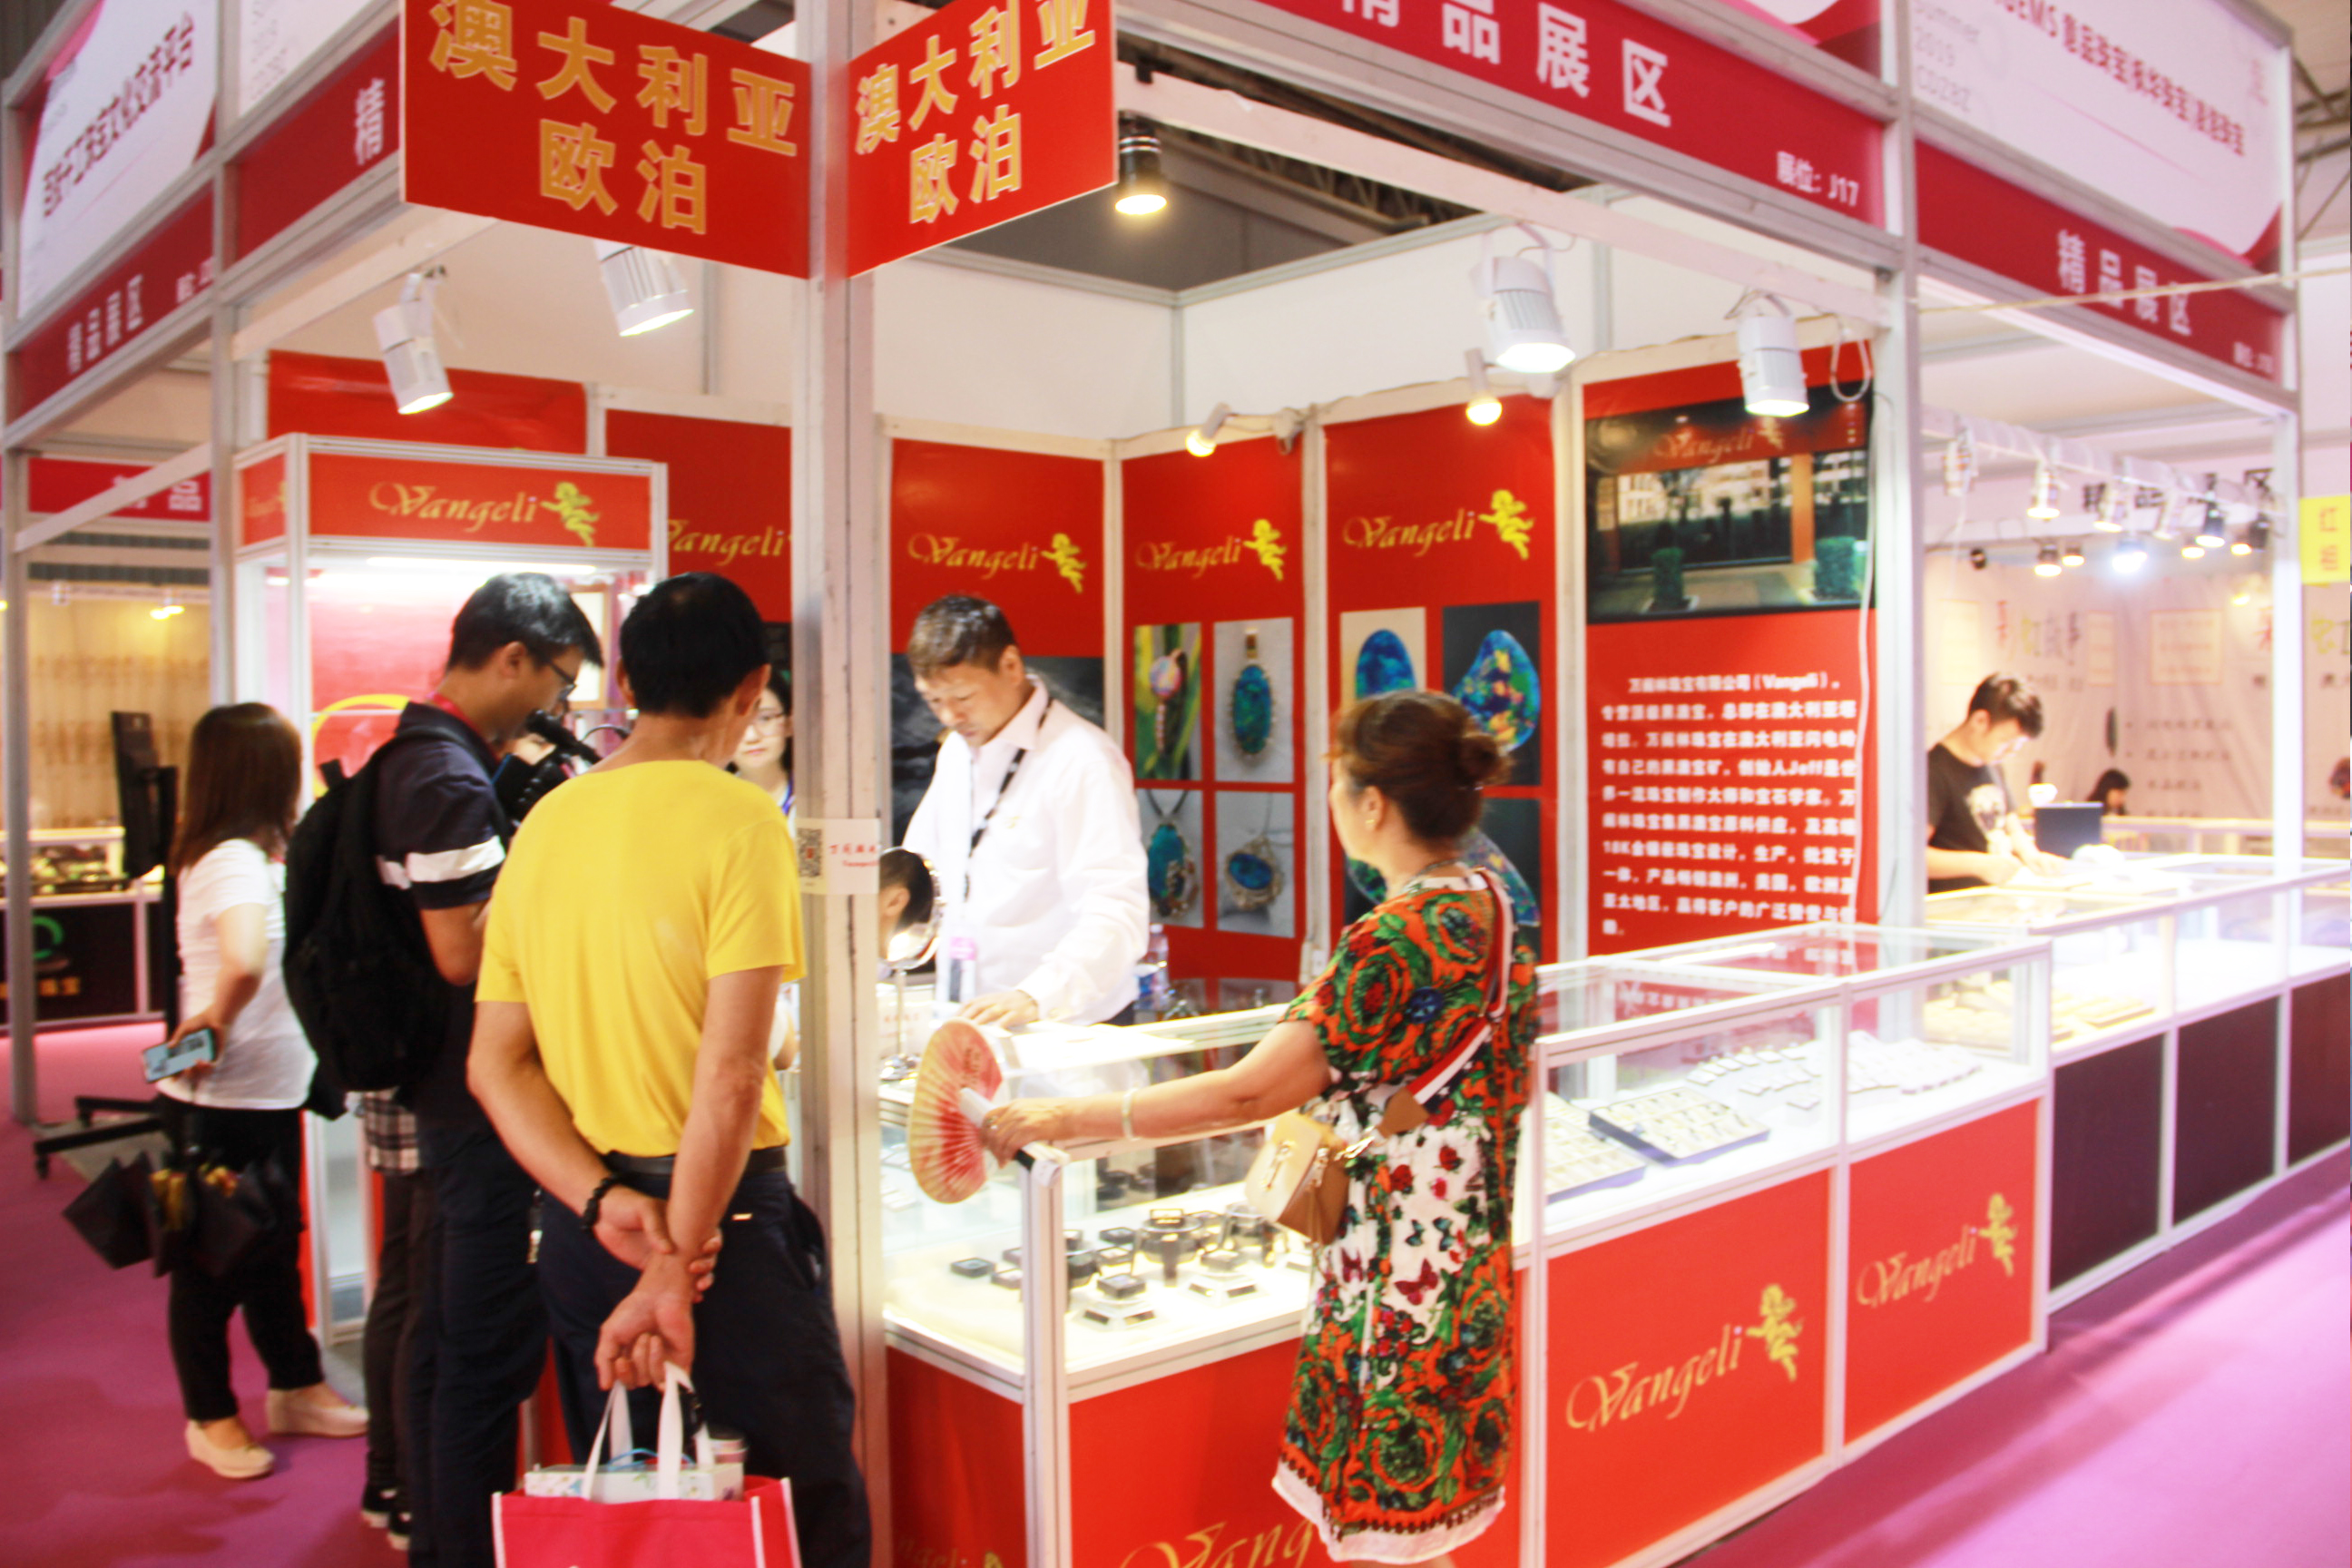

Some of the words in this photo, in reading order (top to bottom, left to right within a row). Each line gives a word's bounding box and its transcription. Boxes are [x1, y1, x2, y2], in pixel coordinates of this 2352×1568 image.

[430, 0, 798, 157] 澳大利亚
[857, 0, 1096, 154] 澳大利亚
[540, 118, 709, 235] 欧泊
[909, 104, 1023, 225] 欧泊
[1828, 173, 1859, 207] J17
[368, 481, 539, 532] Vangeli
[1341, 507, 1477, 557] Vangeli
[907, 531, 1040, 579] Vangeli
[1132, 536, 1243, 579] Vangeli
[1855, 1225, 1980, 1308] Vangeli
[1564, 1323, 1743, 1431] Vangeli
